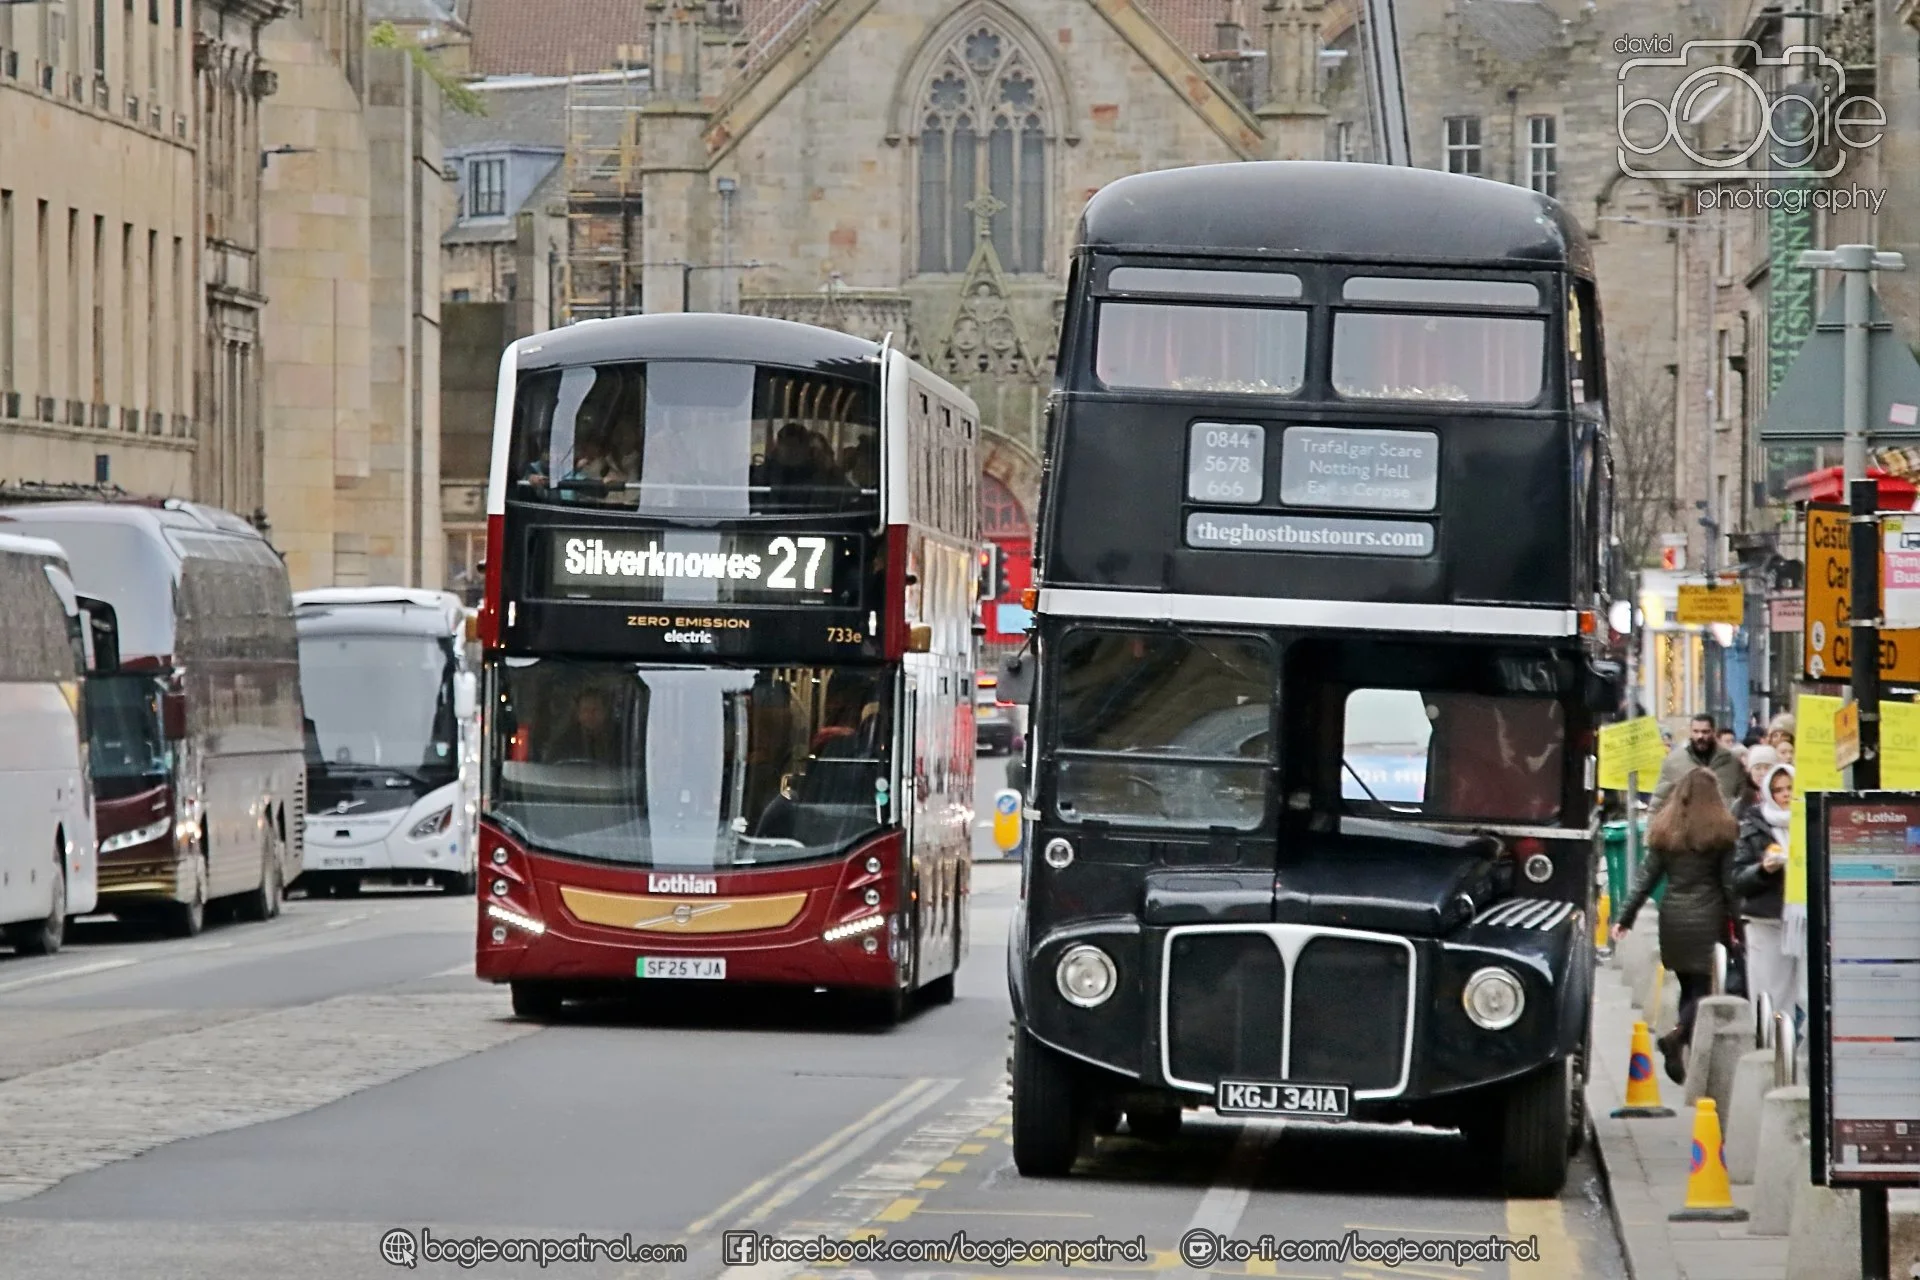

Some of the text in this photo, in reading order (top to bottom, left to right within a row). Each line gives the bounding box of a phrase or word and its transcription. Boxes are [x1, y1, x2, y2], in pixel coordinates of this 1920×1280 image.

[1205, 430, 1250, 449] 0844
[1301, 438, 1423, 459] Trafalgar Scare
[1204, 455, 1250, 473] 5678
[1309, 460, 1411, 480] Notting Hell
[1207, 481, 1245, 497] 666
[1353, 482, 1411, 500] Corpse
[1196, 521, 1425, 546] theghostbustours.com
[564, 537, 826, 590] Silverknowes 27
[627, 615, 750, 629] ZERO EMISSION
[664, 629, 713, 644] electric
[826, 627, 862, 643] 733e
[1866, 811, 1908, 823] Lothian
[648, 873, 718, 894] Lothian
[647, 961, 721, 977] SF25 YJA
[1227, 1085, 1279, 1109] KGJ
